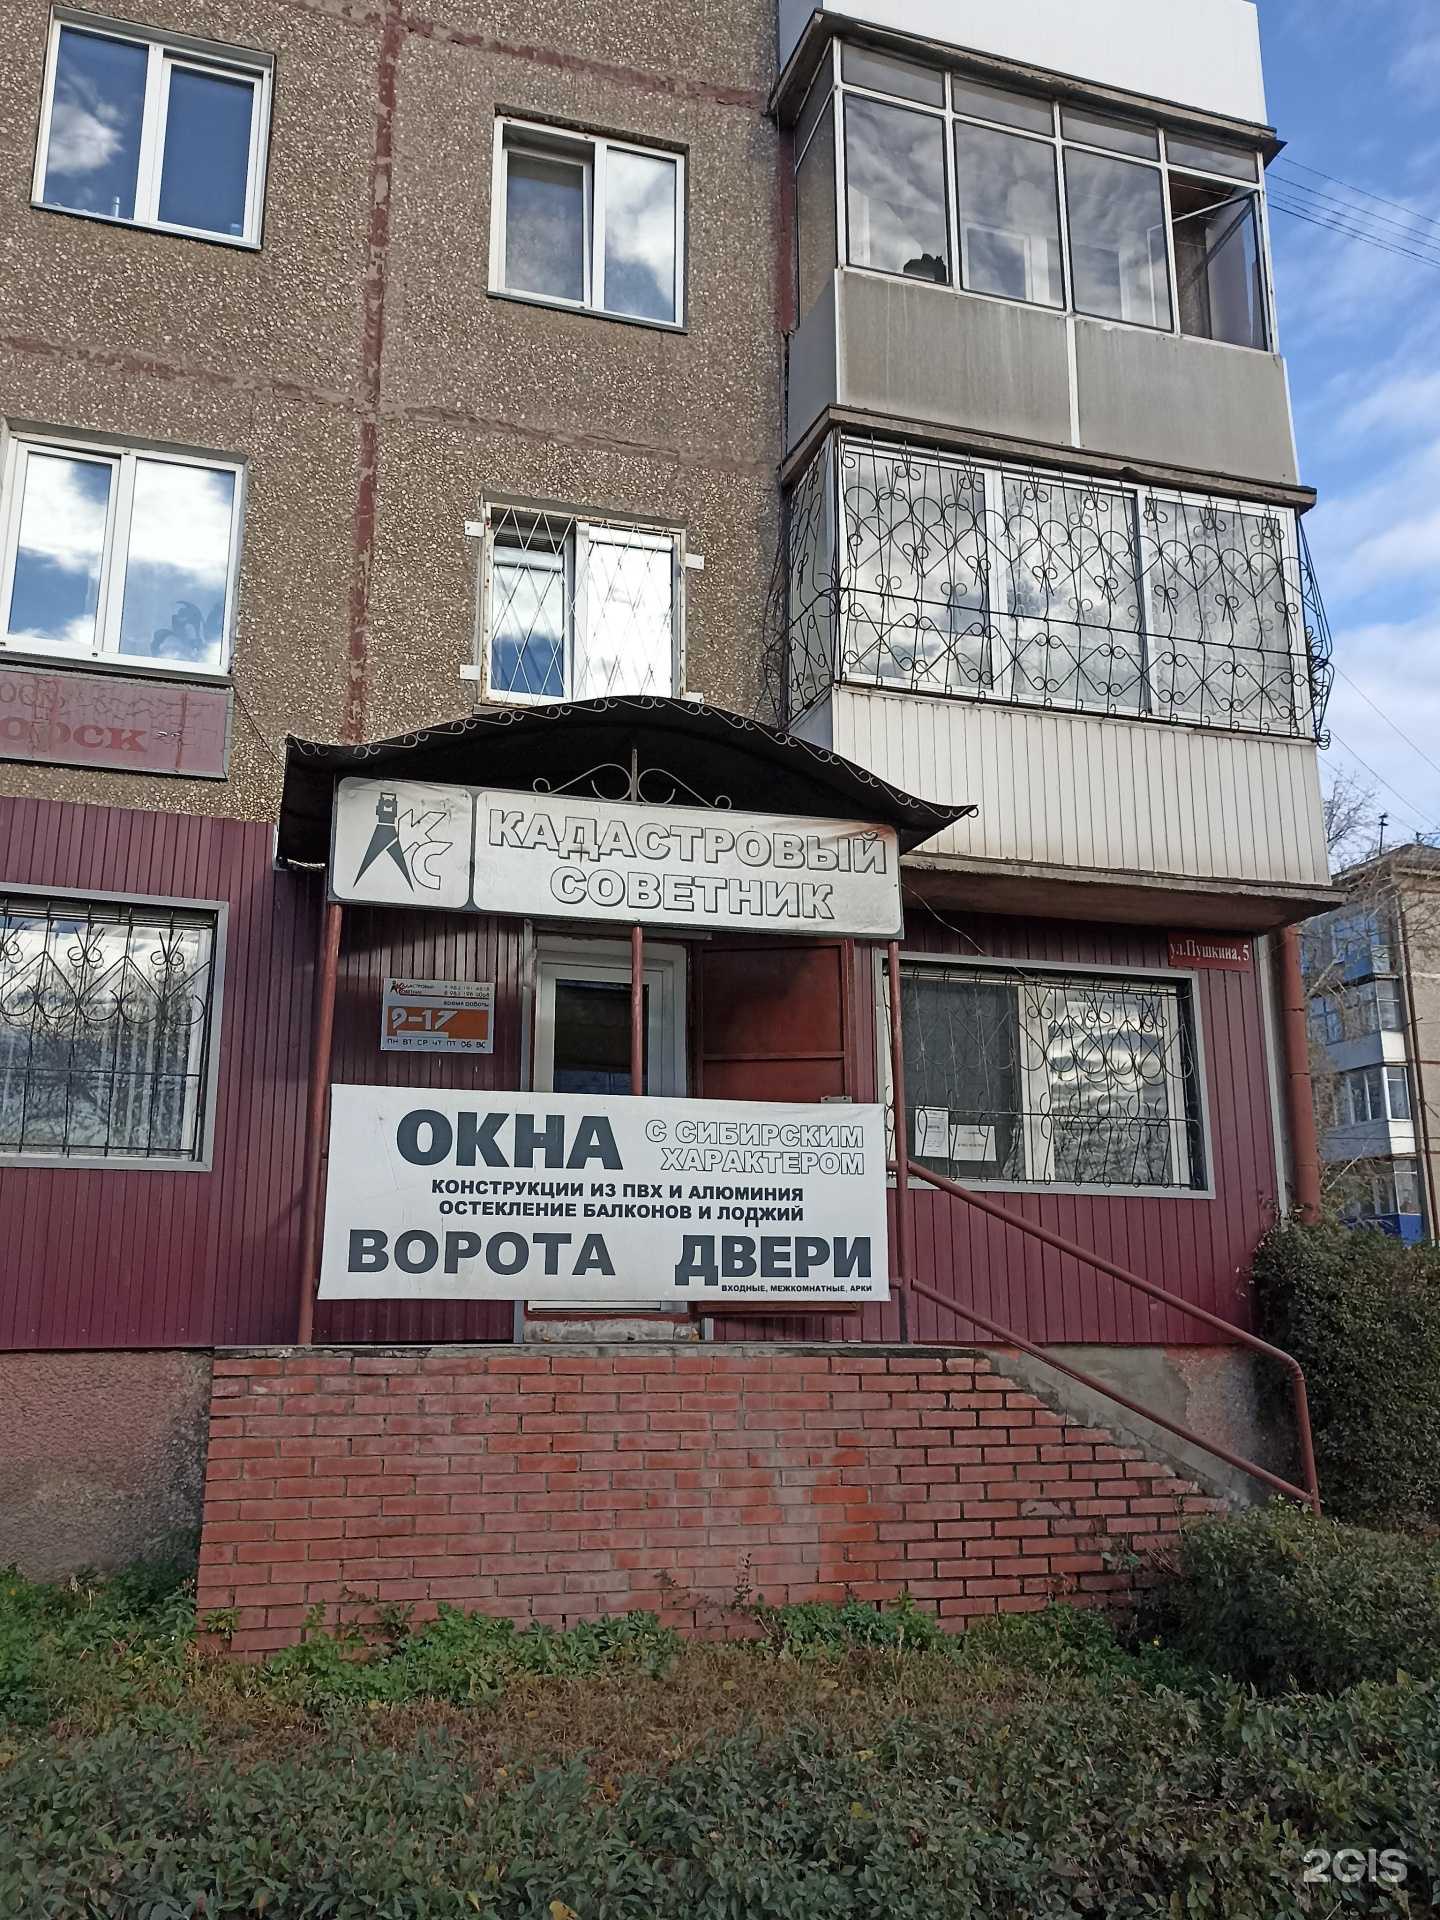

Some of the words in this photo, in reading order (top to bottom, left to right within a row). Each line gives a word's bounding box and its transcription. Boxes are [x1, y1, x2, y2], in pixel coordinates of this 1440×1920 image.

[489, 809, 886, 874] КАДАСТРОВЫЙ
[550, 866, 835, 919] СОВЕТНИК
[397, 1109, 624, 1170] ОКНА
[645, 1120, 667, 1143] С
[675, 1121, 863, 1148] СИБИРСКИМ
[660, 1148, 864, 1175] ХАРАКТЕРОМ
[432, 1179, 584, 1199] КОНСТРУКЦИИ
[590, 1183, 616, 1198] ИЗ
[623, 1184, 663, 1199] ПВХ
[669, 1185, 682, 1199] И
[688, 1186, 804, 1201] АЛЮМИНИЯ
[439, 1200, 577, 1217] ОСТЕКЛЕНИЕ
[583, 1203, 692, 1220] БАЛКОНОВ
[699, 1205, 712, 1220] И
[717, 1205, 804, 1227] ЛОДЖИЙ
[348, 1229, 616, 1276] ВОРОТА
[675, 1235, 872, 1286] ДВЕРИ
[721, 1285, 768, 1293] ВХОДНЫЕ,
[770, 1285, 848, 1293] МЕЖКОМНАТНЫЕ,
